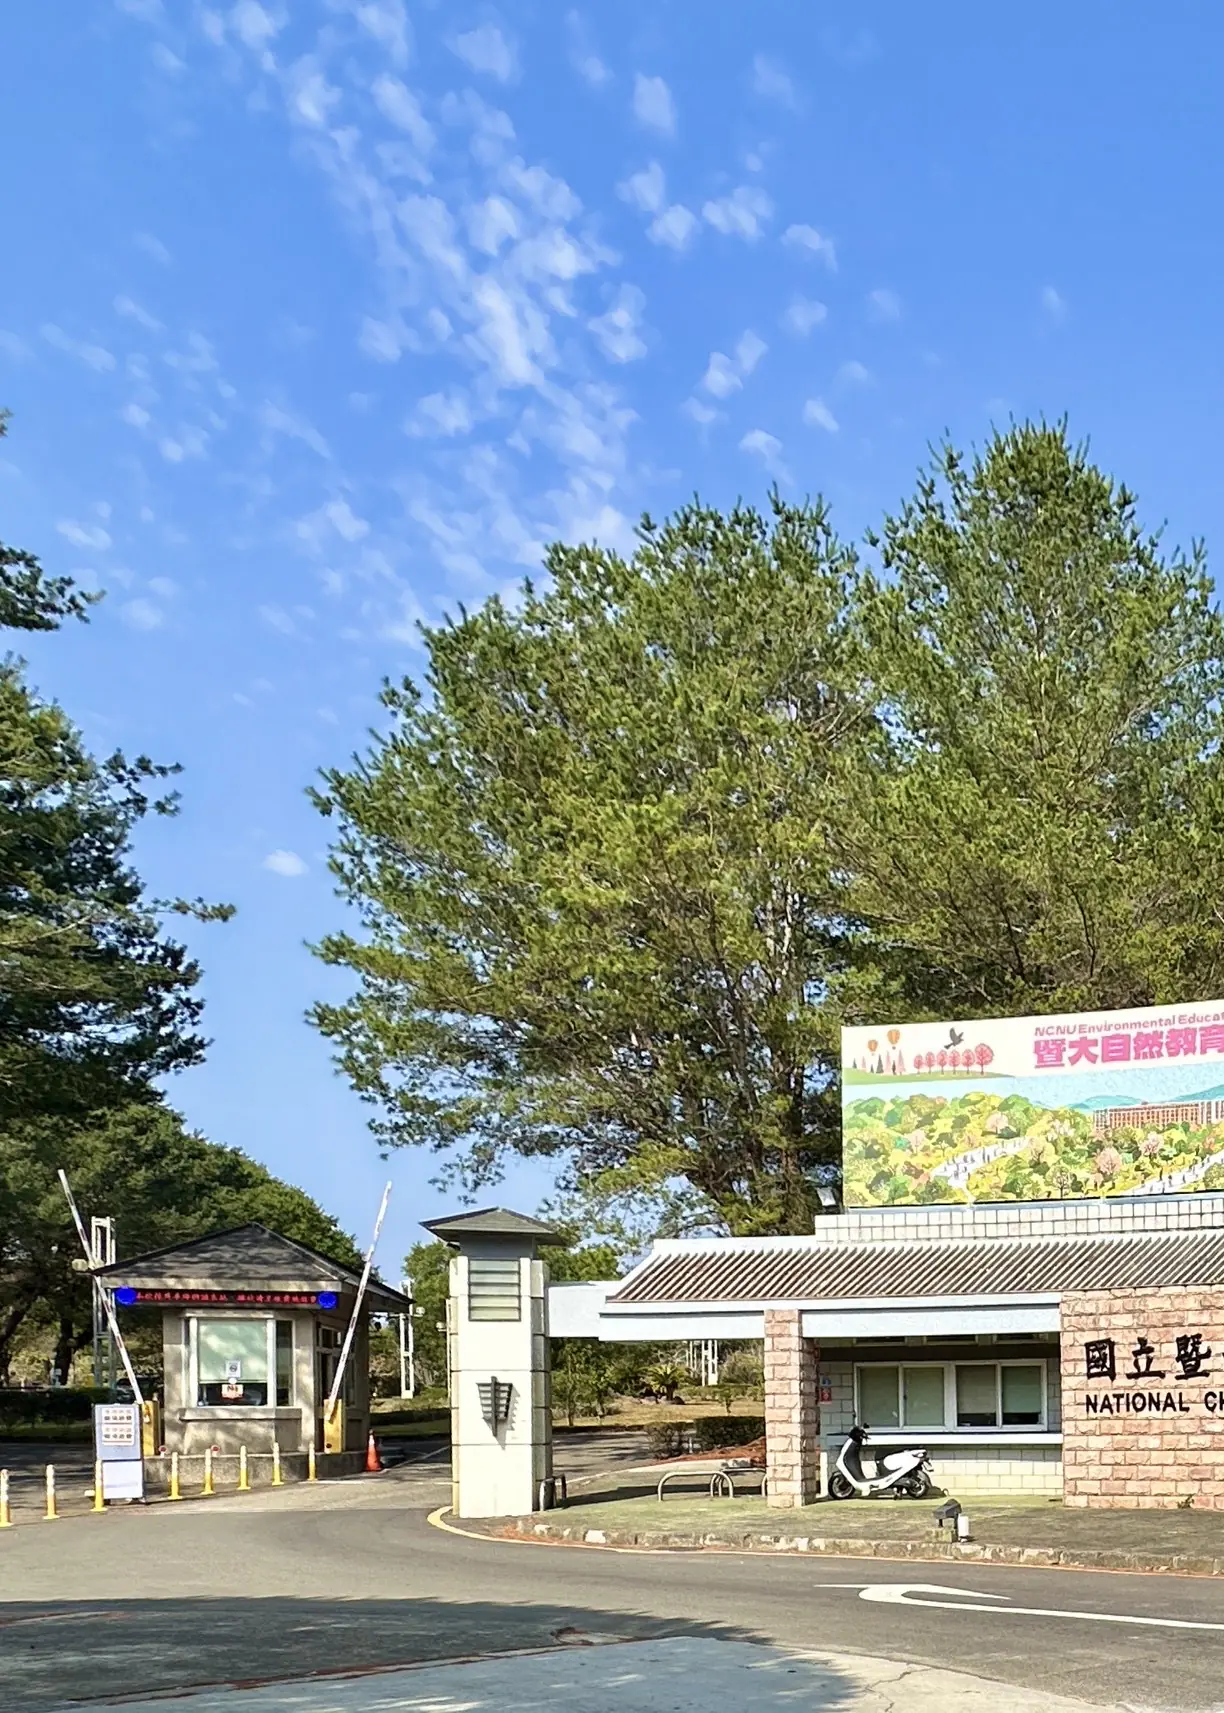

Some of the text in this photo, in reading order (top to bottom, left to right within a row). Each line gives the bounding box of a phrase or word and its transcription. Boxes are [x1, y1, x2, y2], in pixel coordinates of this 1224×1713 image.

[1035, 1023, 1076, 1037] NCNU
[1078, 1014, 1176, 1034] Environmental
[1085, 1390, 1190, 1415] NATIONAL
